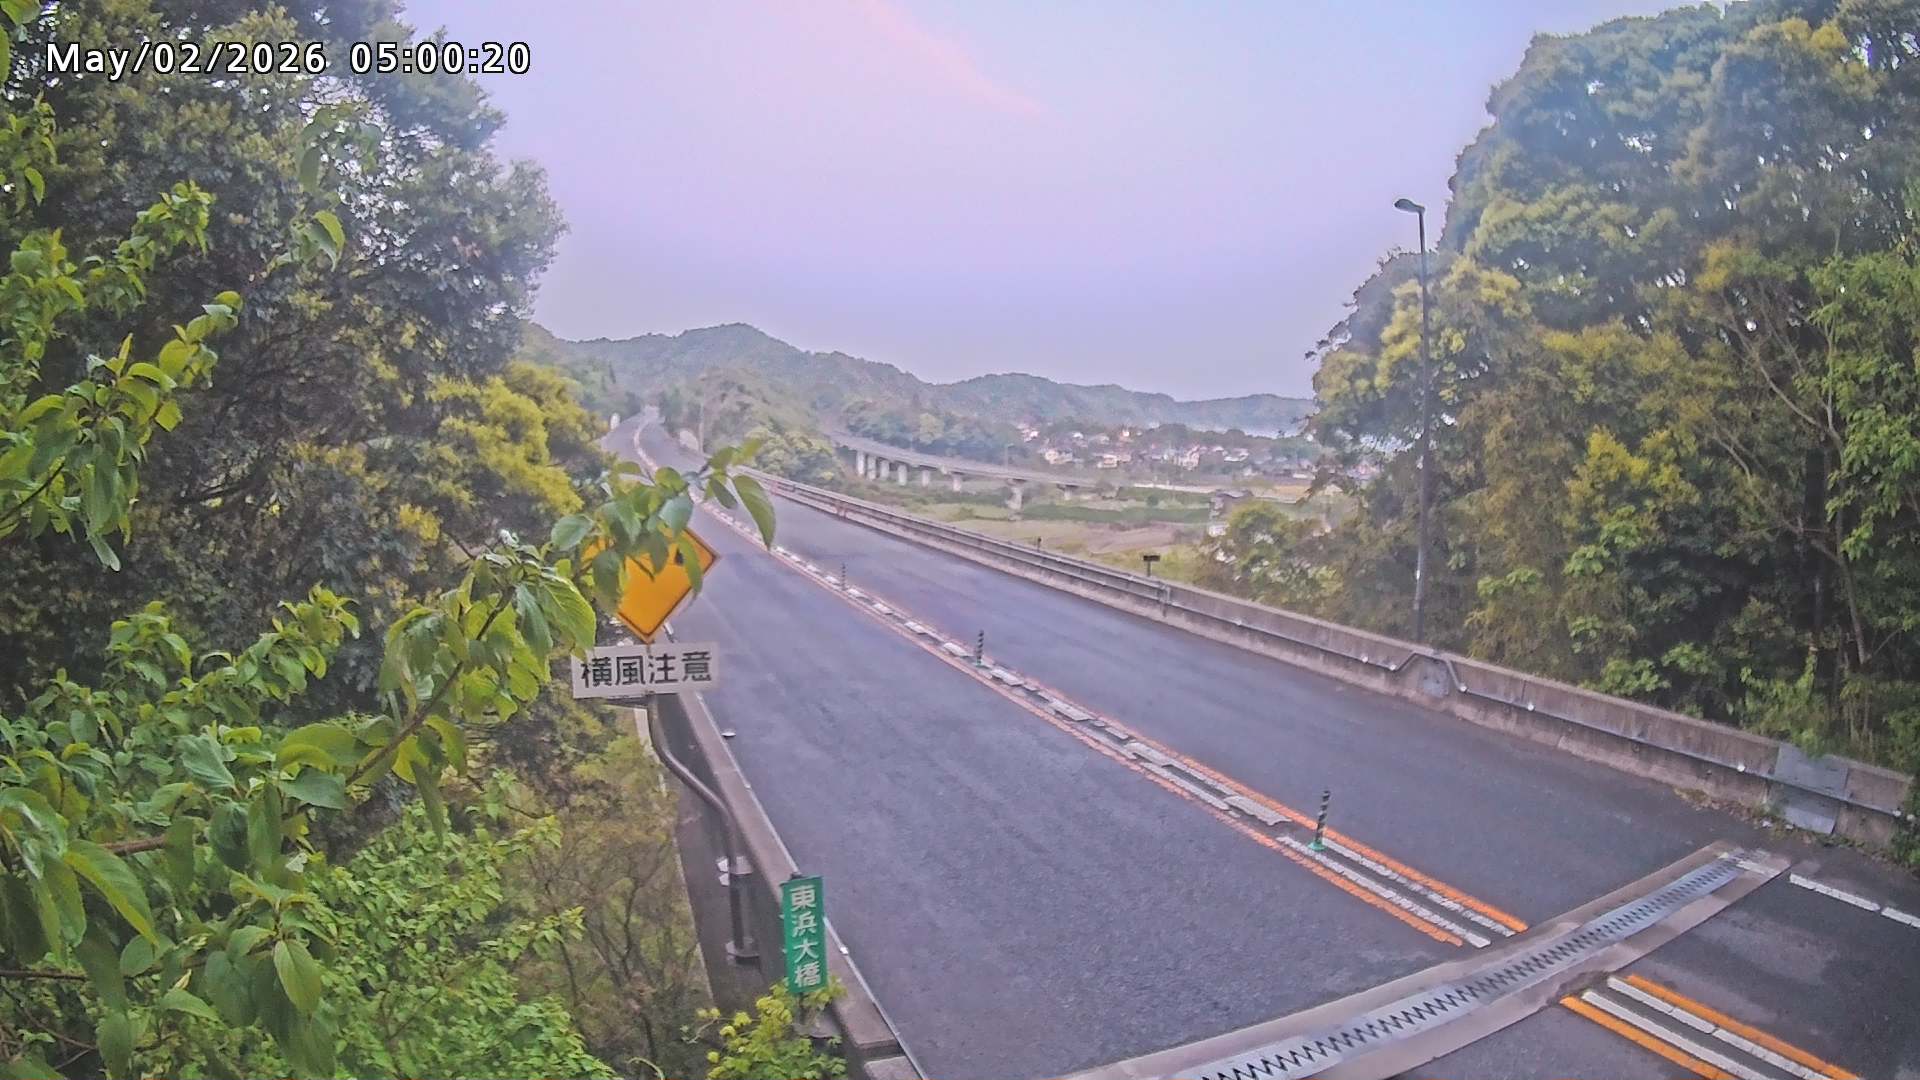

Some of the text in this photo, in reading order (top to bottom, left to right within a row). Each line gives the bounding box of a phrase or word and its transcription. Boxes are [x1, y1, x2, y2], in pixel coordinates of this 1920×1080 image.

[581, 651, 712, 688] 横風注意
[789, 884, 821, 988] 東浜大橋
